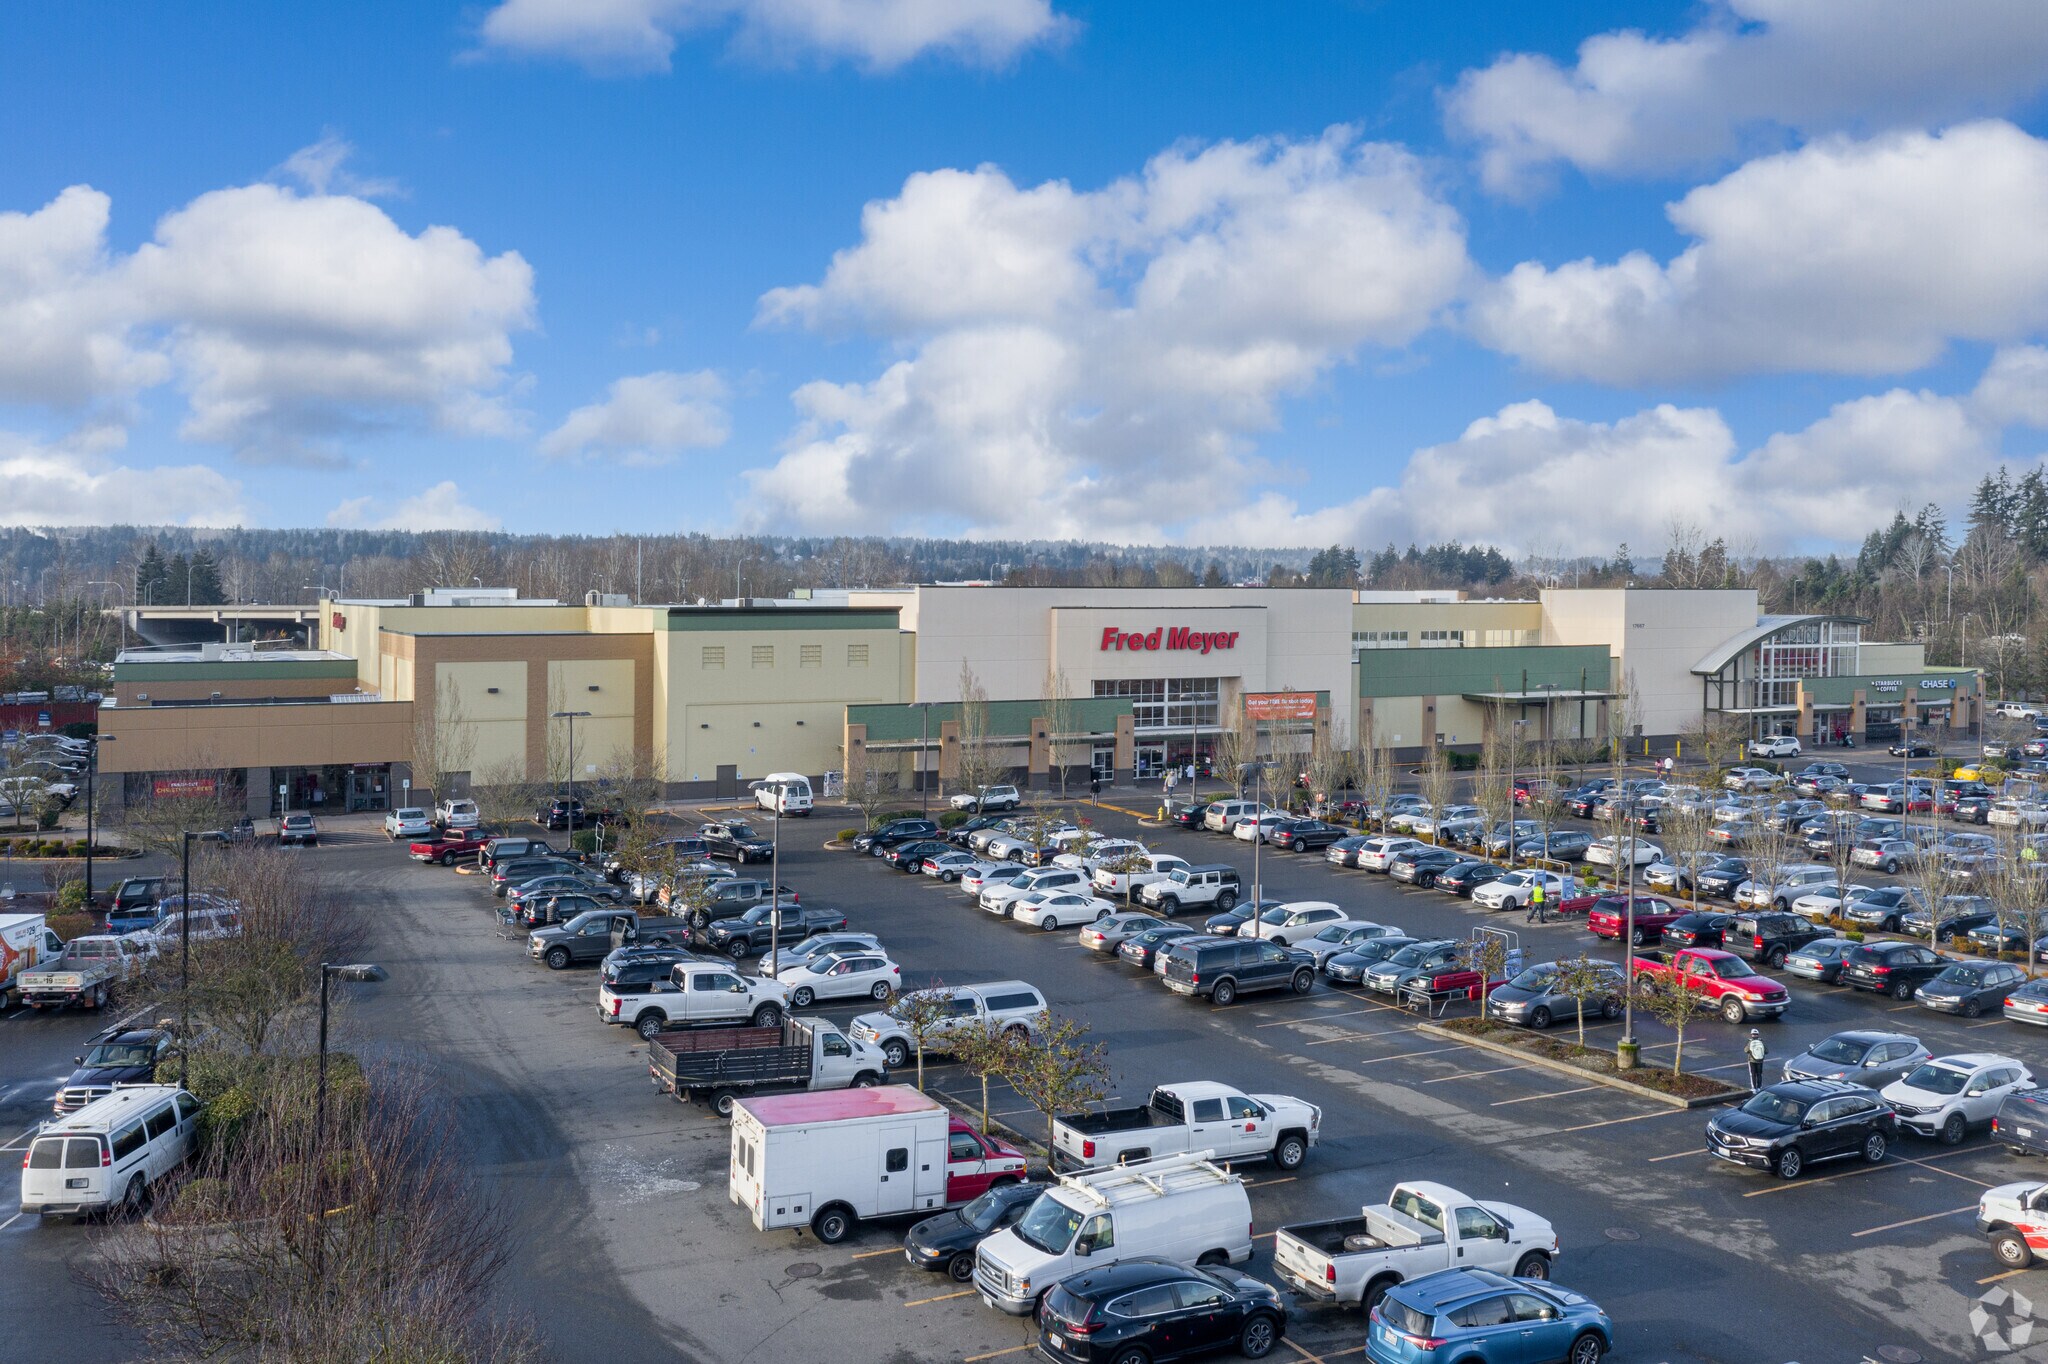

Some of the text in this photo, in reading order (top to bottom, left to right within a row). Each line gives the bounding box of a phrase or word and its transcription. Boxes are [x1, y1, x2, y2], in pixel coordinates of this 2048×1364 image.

[1100, 626, 1239, 655] Fred Meyer
[1921, 680, 1948, 688] CHASE
[27, 925, 35, 935] $29
